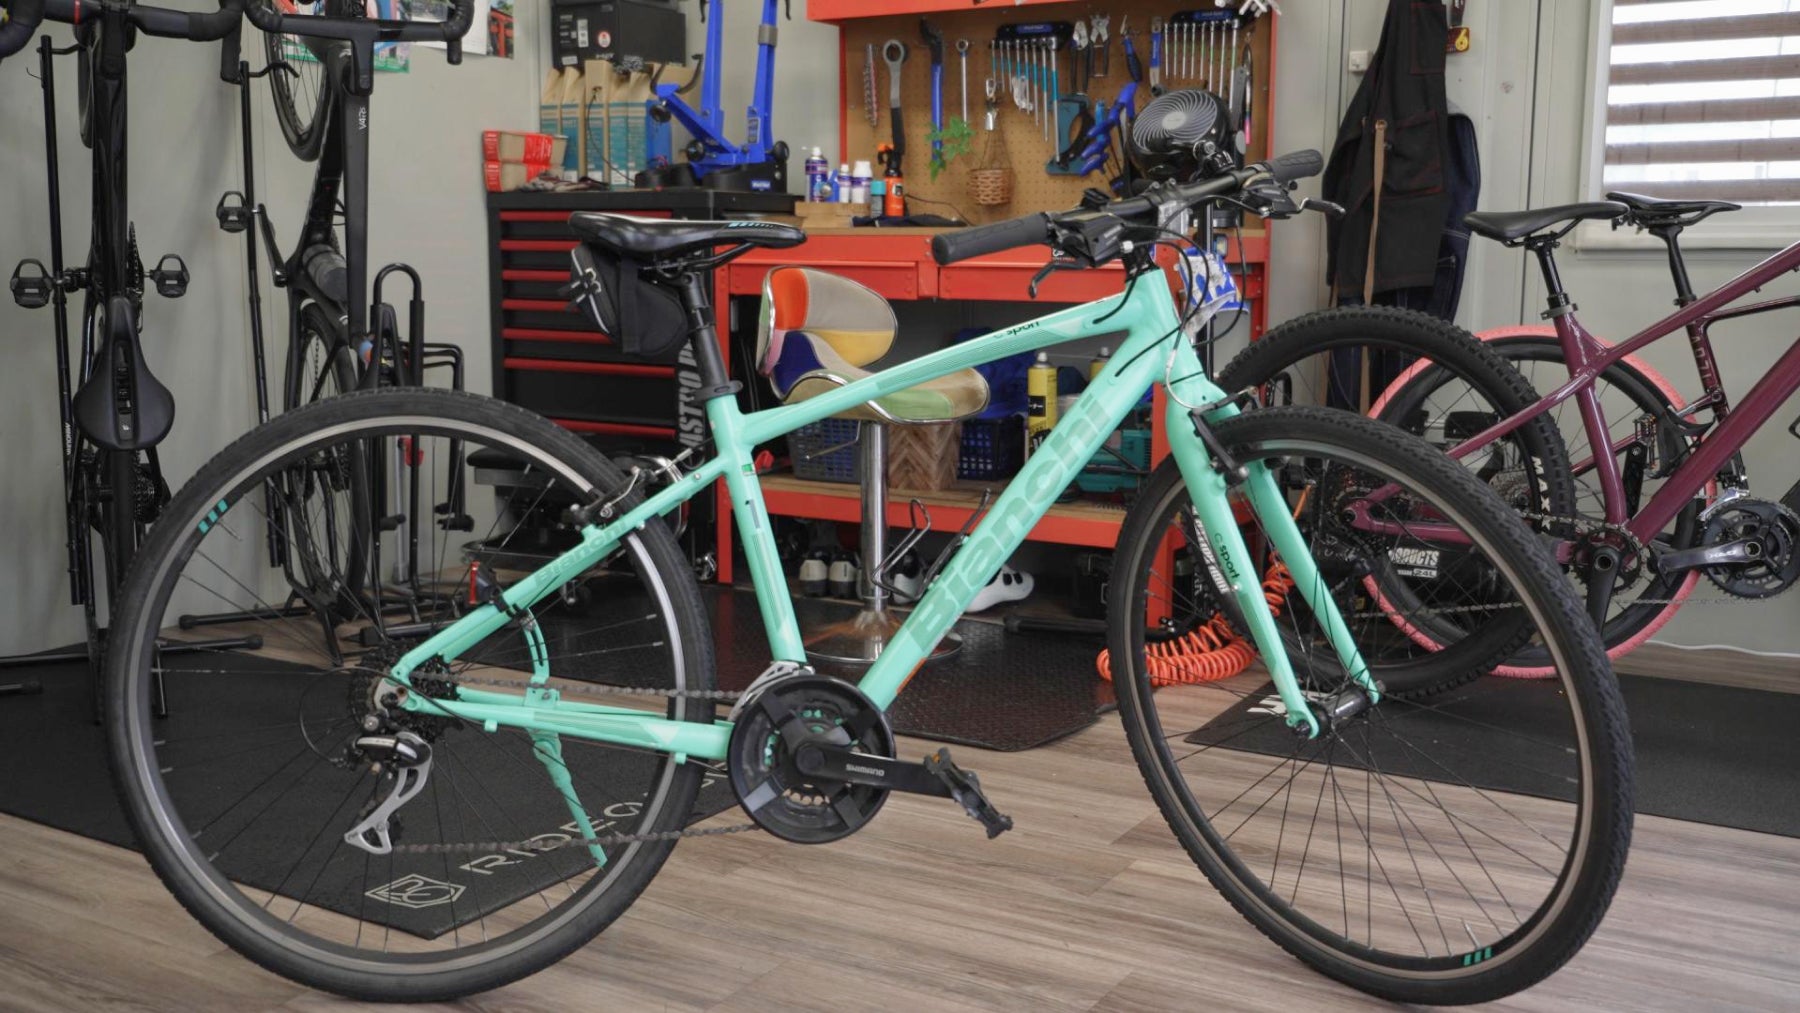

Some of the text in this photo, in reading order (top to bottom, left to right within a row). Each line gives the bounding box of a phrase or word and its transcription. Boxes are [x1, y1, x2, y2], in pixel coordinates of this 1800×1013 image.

[905, 393, 1111, 652] Bianchi
[1220, 545, 1240, 578] sport
[846, 763, 885, 777] SHIMANO
